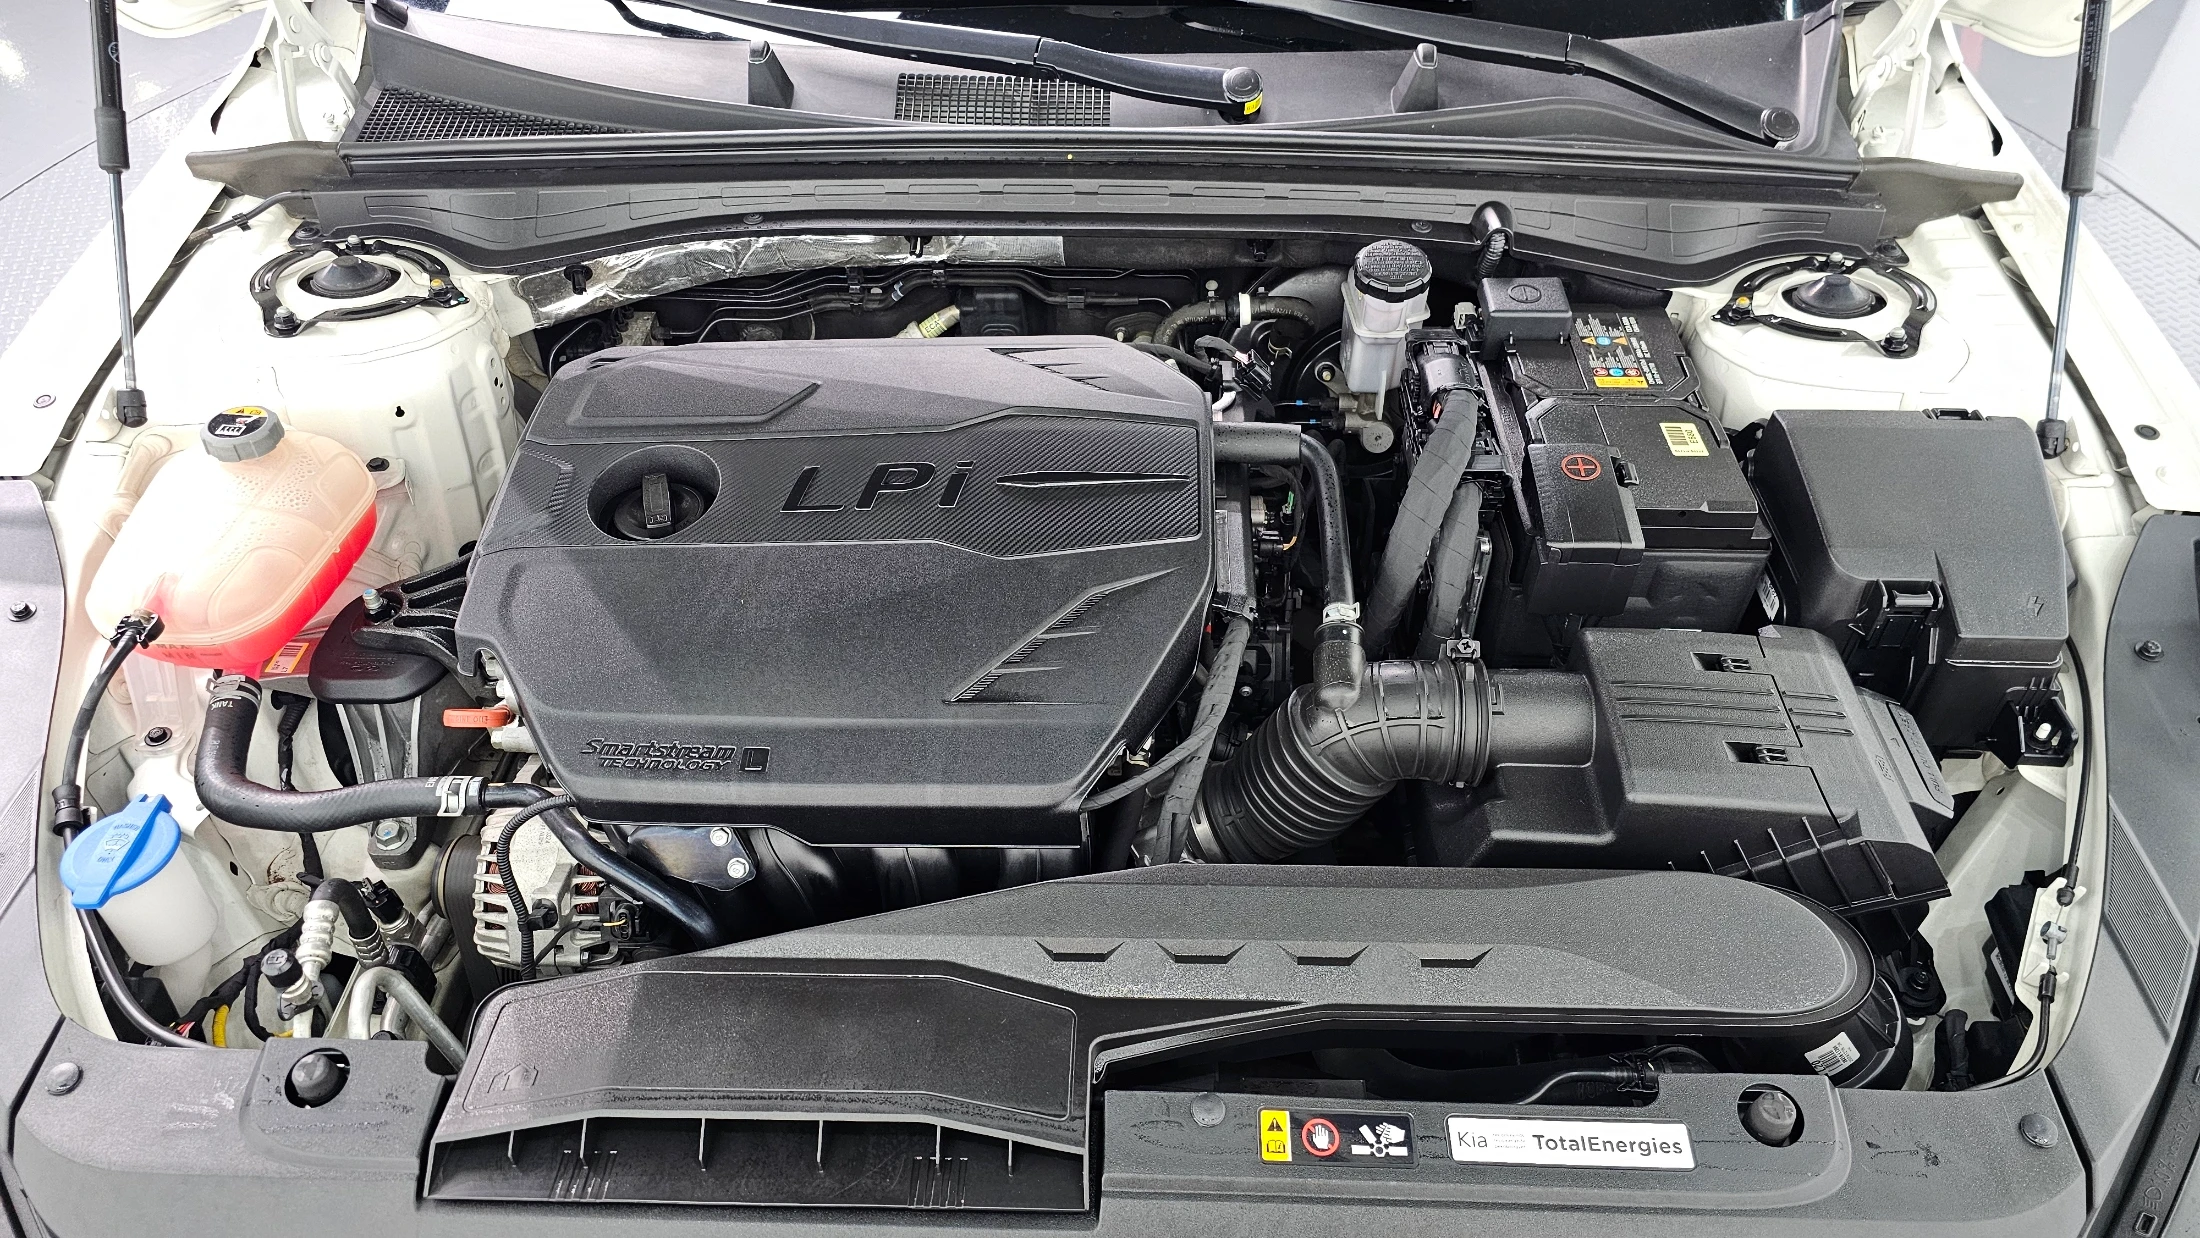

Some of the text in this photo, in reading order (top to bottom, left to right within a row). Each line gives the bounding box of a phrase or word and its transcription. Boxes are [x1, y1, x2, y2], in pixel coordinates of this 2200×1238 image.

[780, 460, 975, 512] LPi
[581, 737, 737, 759] Smartstream
[1457, 1131, 1488, 1149] Kia
[1531, 1134, 1683, 1156] TotalEnergies
